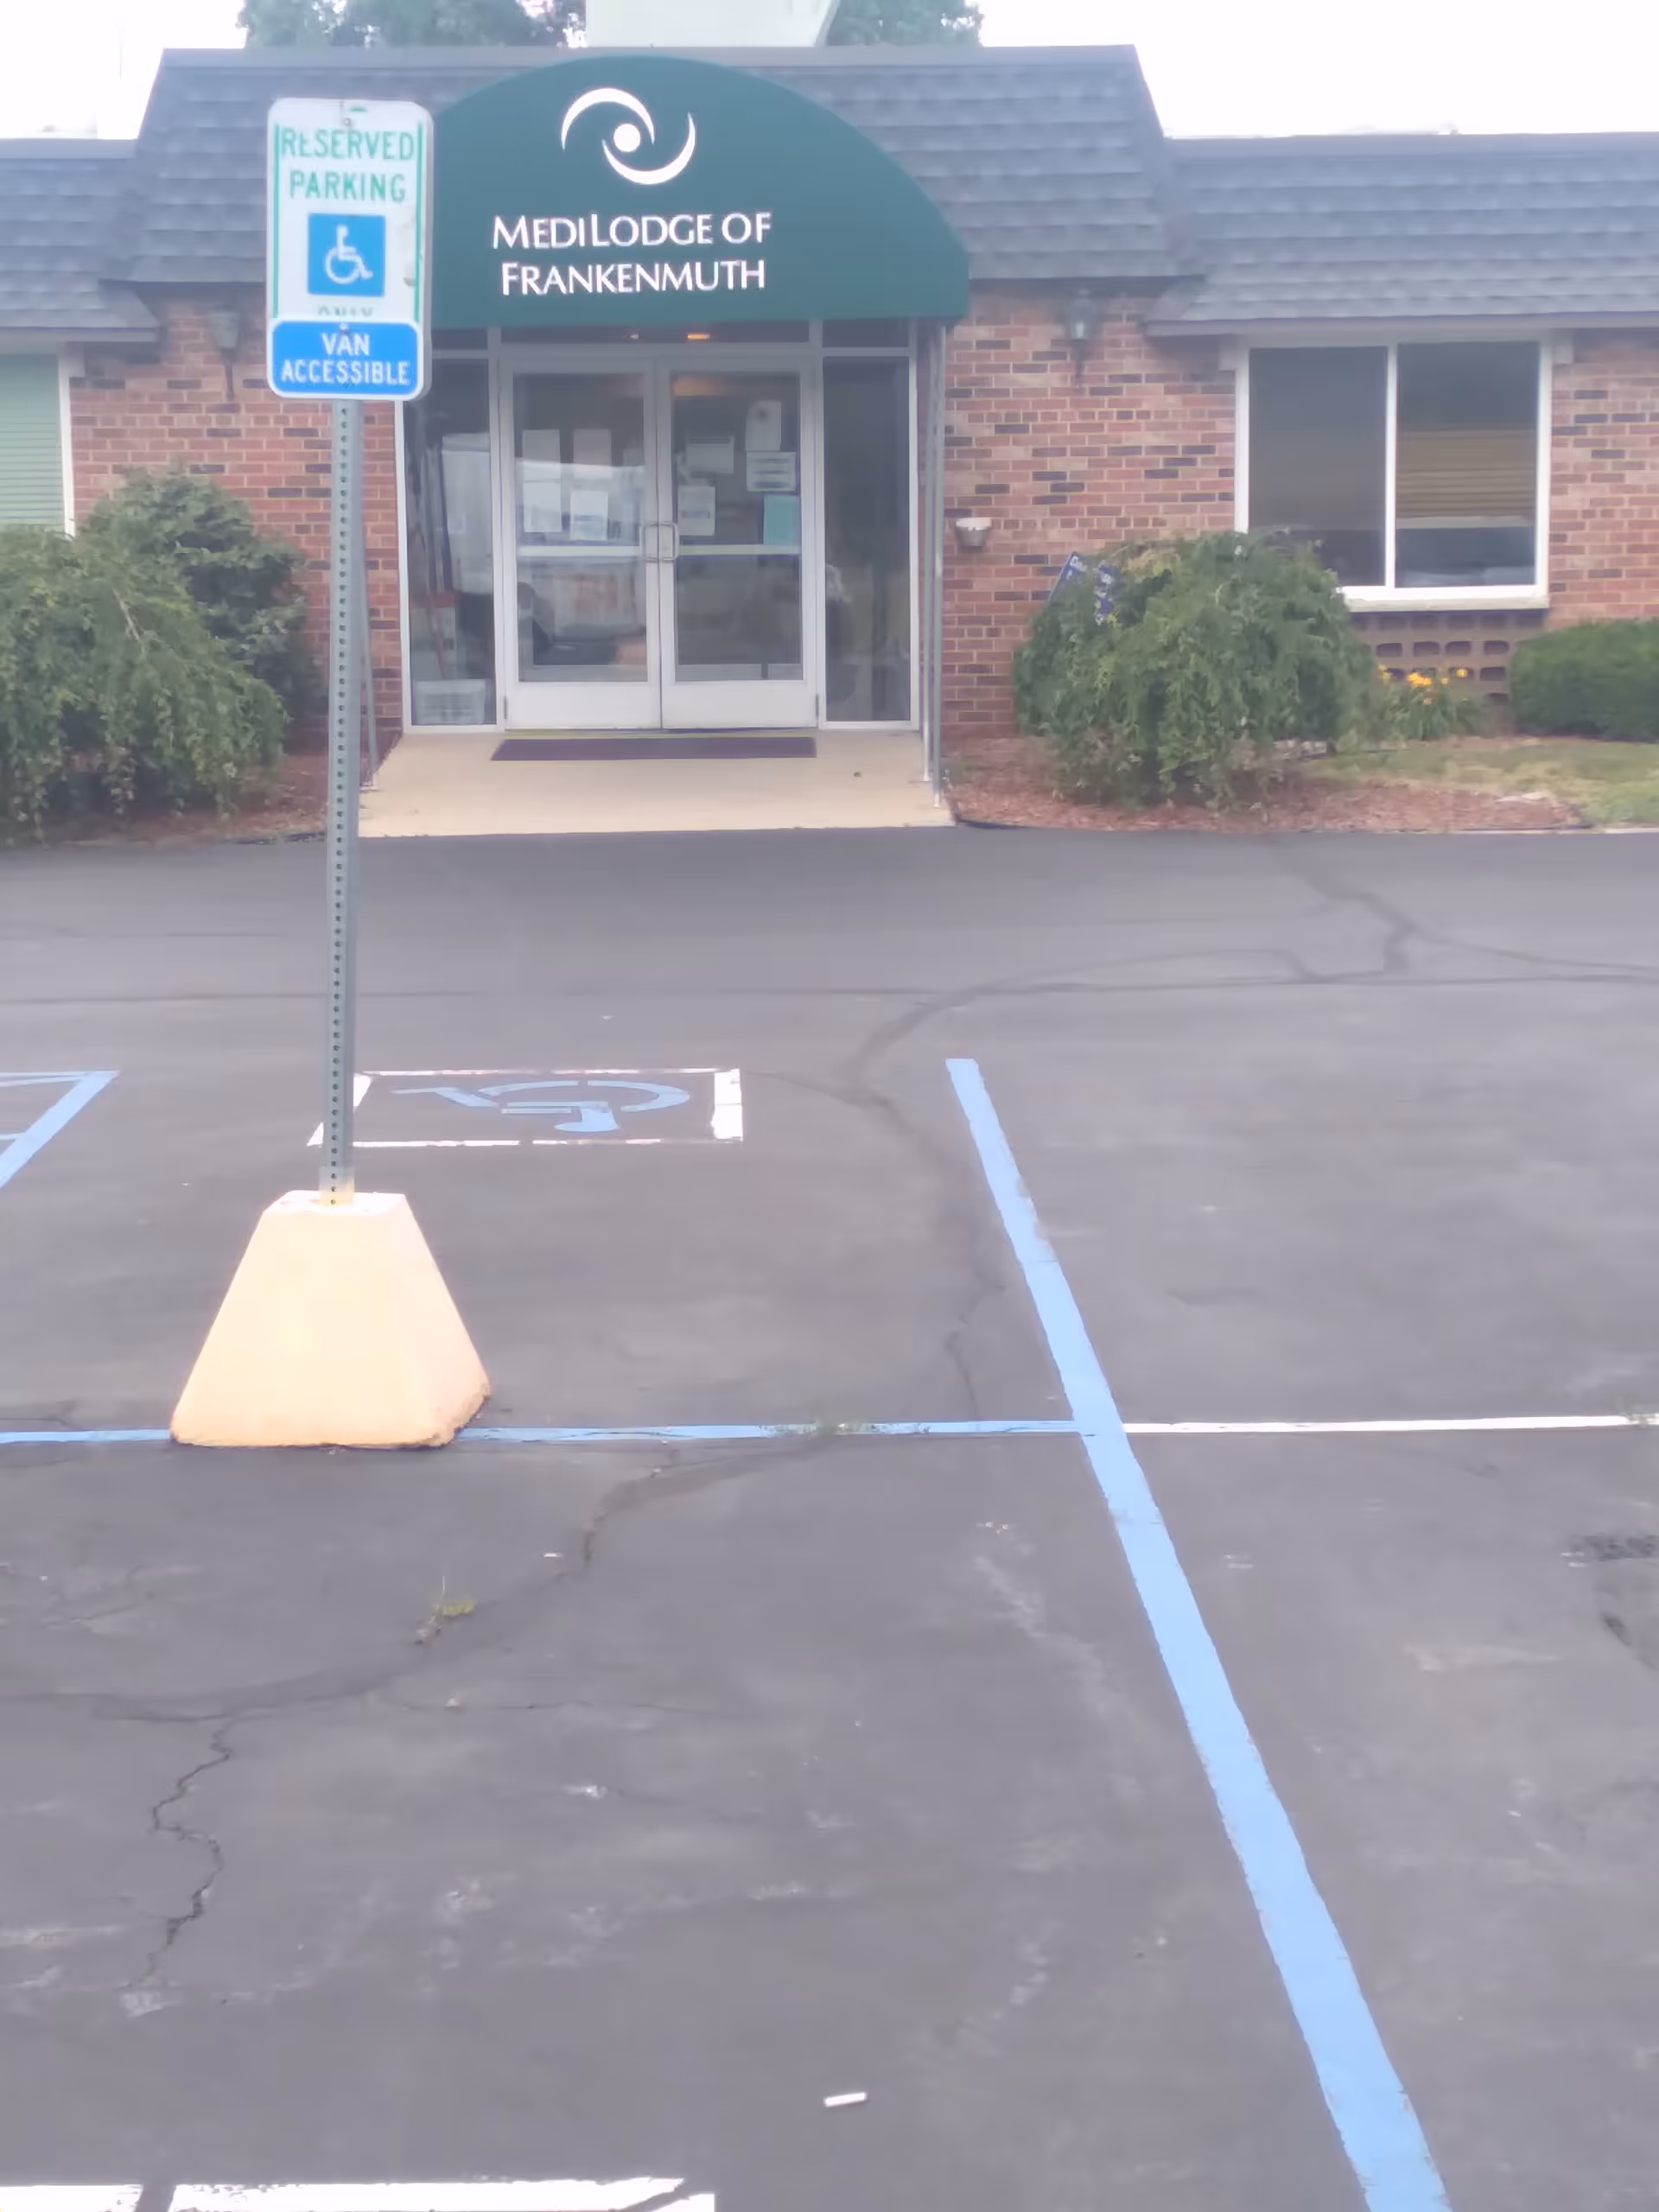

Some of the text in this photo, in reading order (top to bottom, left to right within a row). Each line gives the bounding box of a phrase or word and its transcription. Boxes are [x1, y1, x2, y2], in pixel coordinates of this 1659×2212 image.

[282, 130, 415, 161] RESERVED
[289, 169, 406, 202] PARKING
[721, 212, 772, 245] OF
[501, 260, 766, 296] FRANKENMUTH
[321, 333, 370, 356] VAN
[281, 359, 410, 385] ACCESSIBLE
